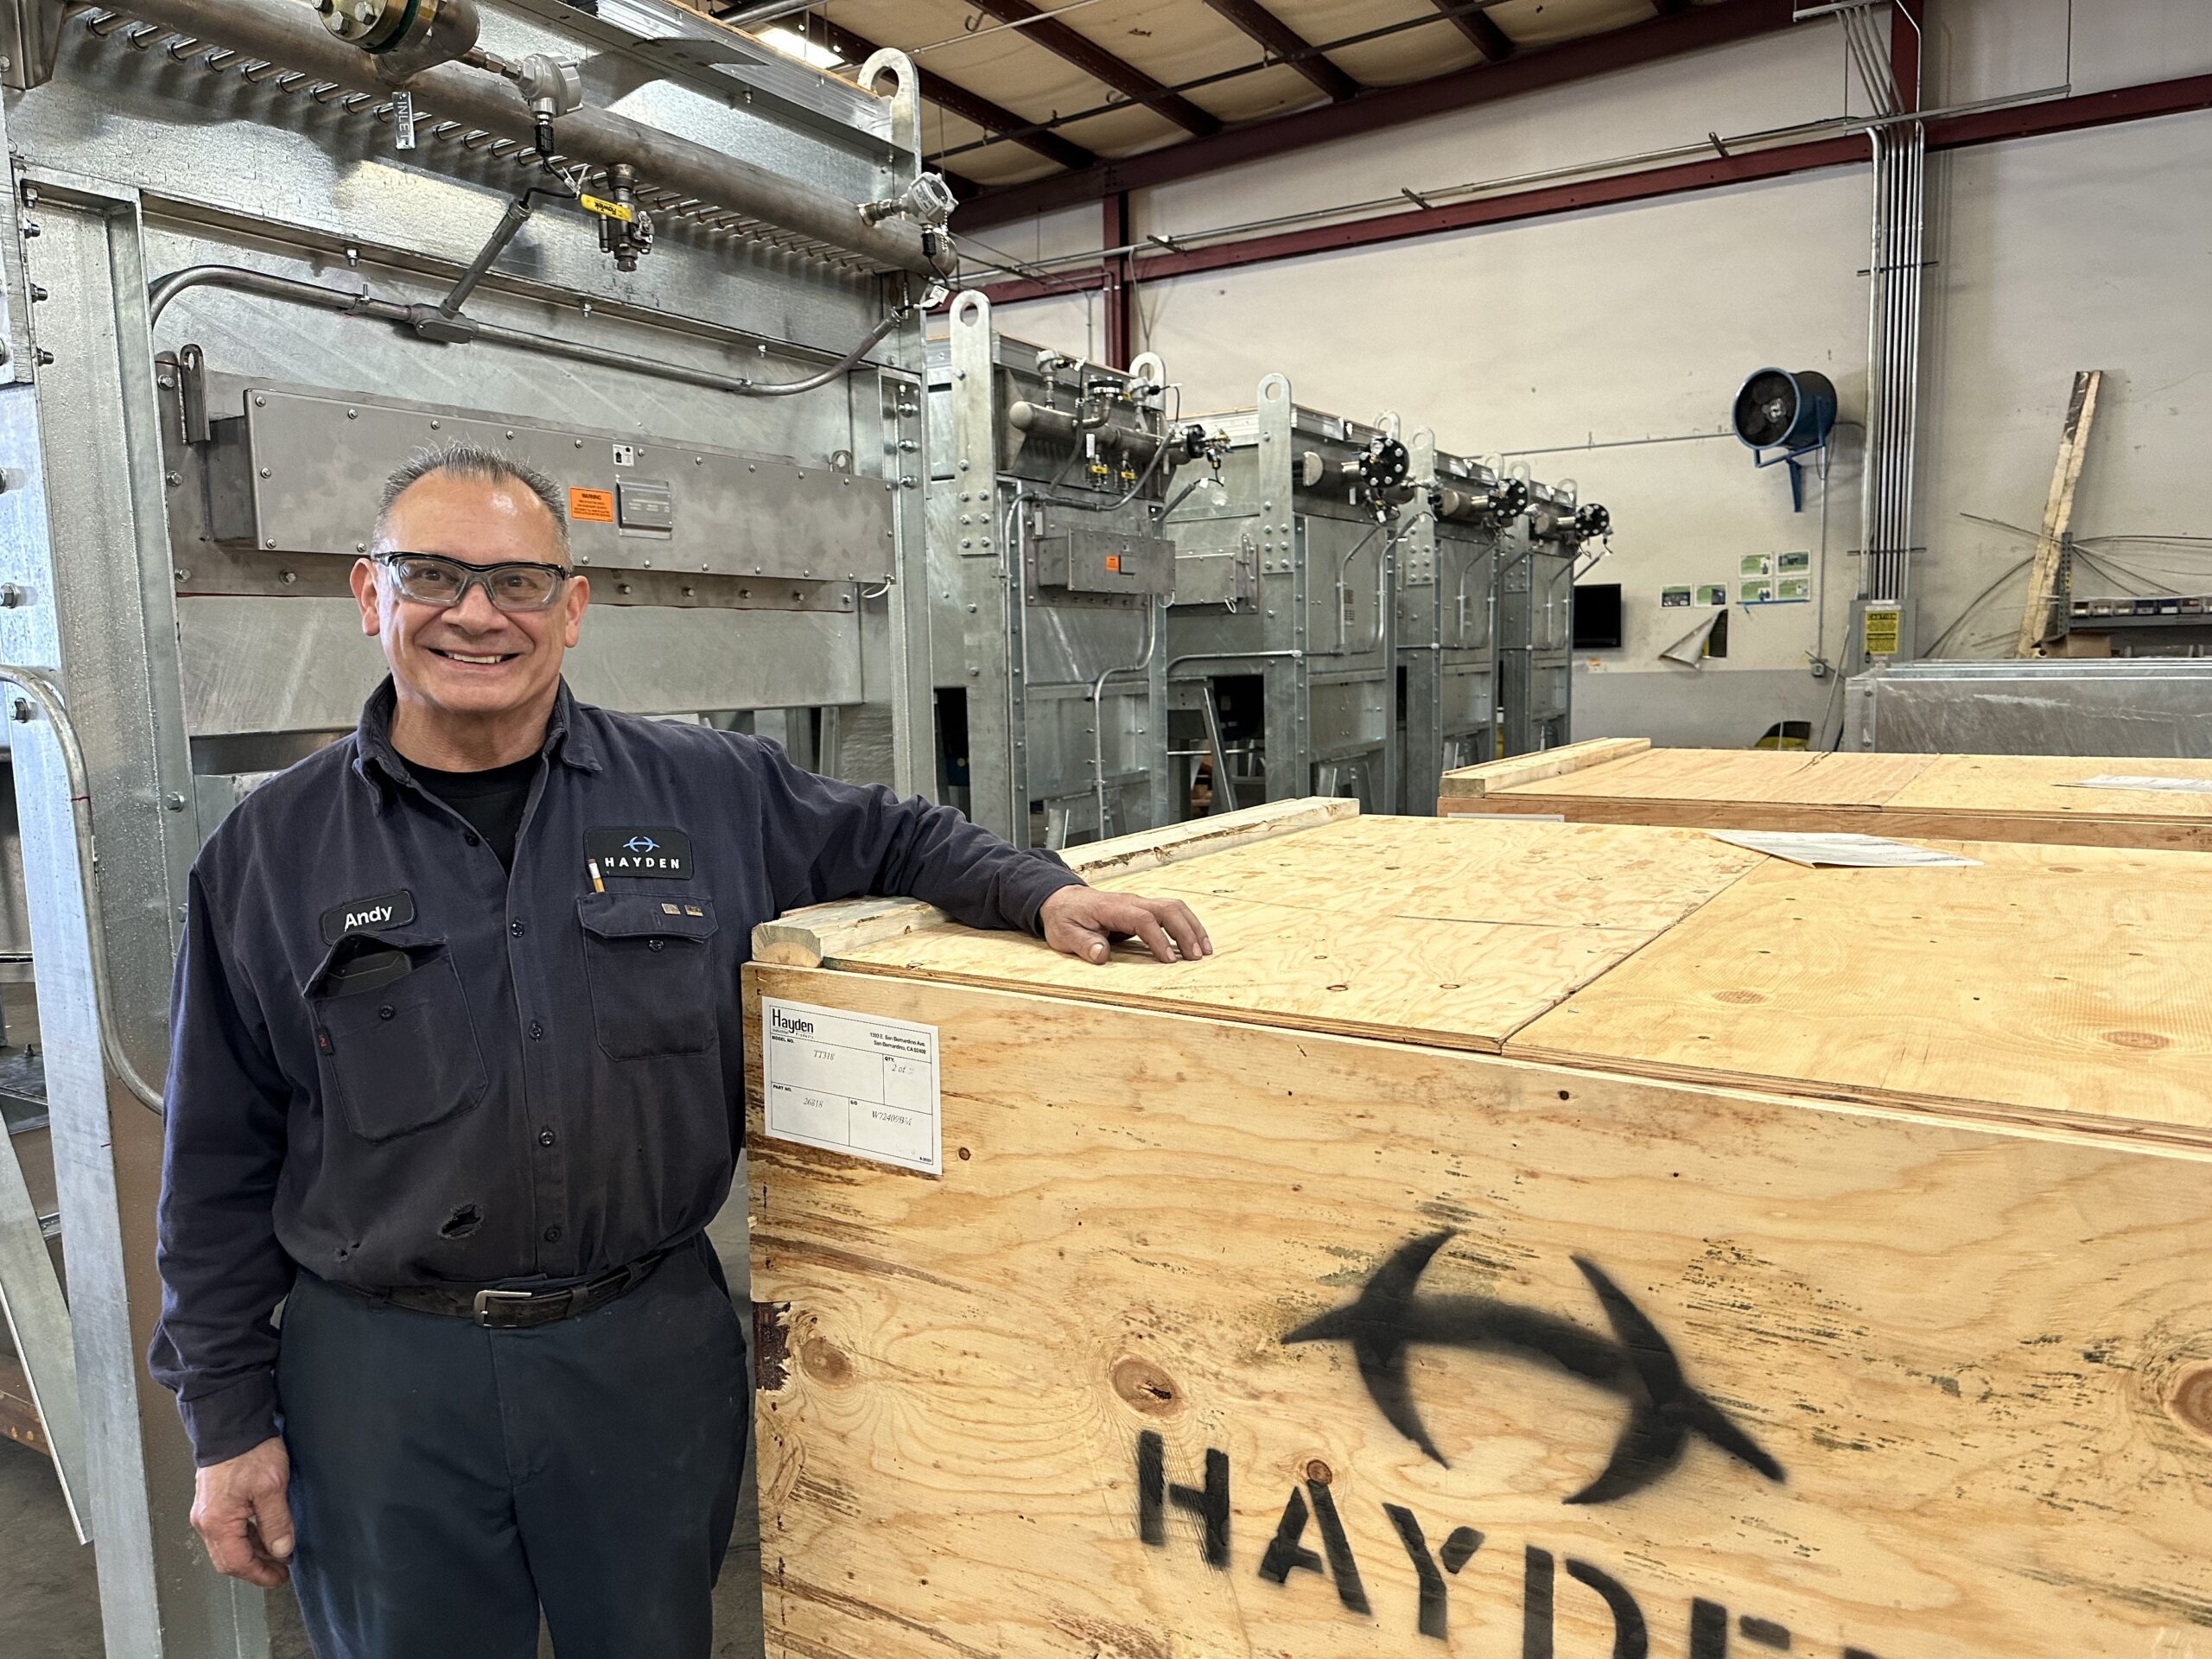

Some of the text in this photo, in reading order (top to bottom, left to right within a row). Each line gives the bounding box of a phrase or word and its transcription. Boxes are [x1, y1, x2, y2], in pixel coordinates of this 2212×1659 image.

[604, 856, 680, 869] HAYDEN
[344, 906, 392, 932] Andy
[772, 1007, 814, 1034] Hayden
[891, 1064, 897, 1072] 2
